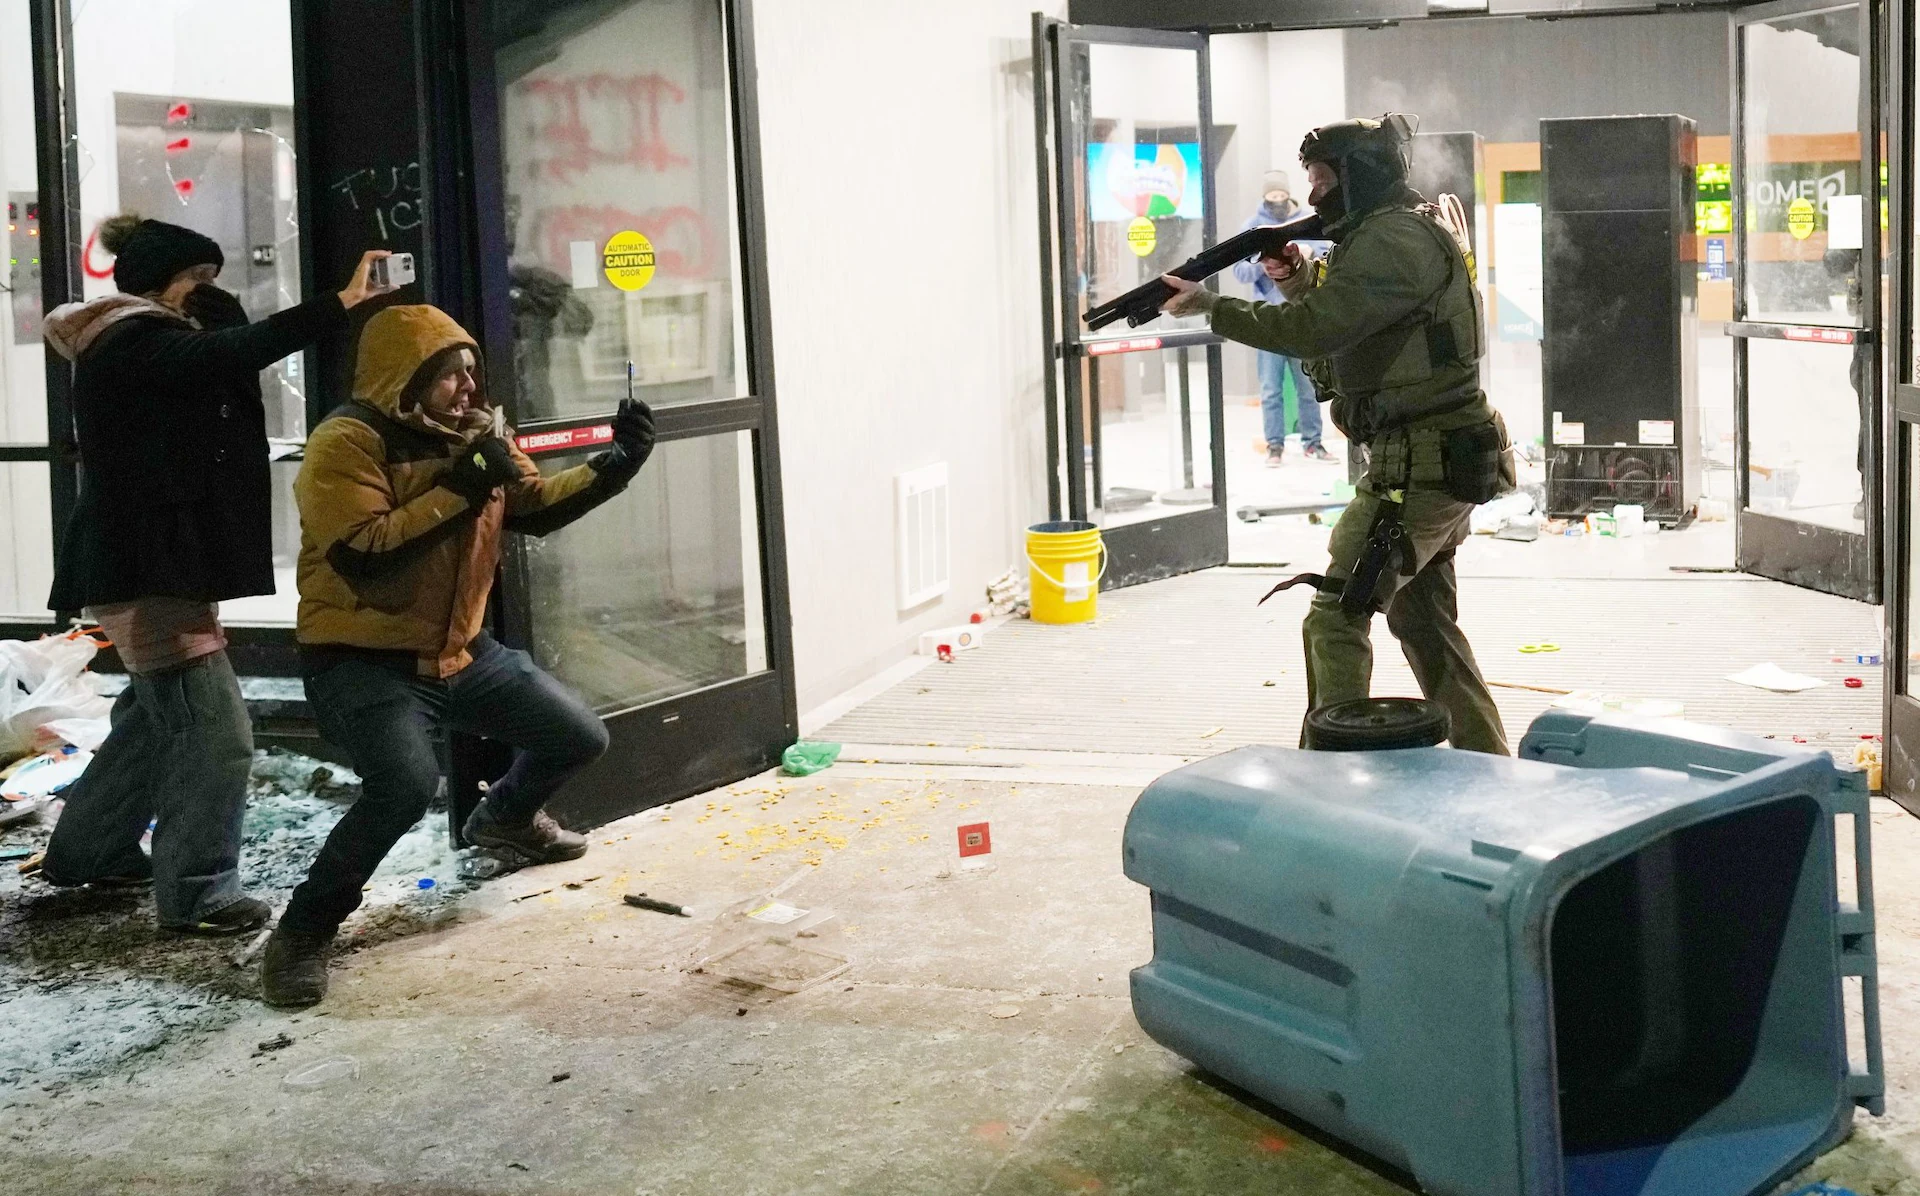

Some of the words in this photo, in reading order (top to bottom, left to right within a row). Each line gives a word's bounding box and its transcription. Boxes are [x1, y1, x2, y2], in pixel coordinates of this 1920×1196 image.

[608, 243, 650, 252] AUTOMATIC
[605, 254, 653, 267] CAUTION
[620, 269, 641, 277] DOOR
[520, 437, 529, 448] IN
[529, 431, 573, 448] EMERGENCY
[593, 425, 612, 439] PUSH
